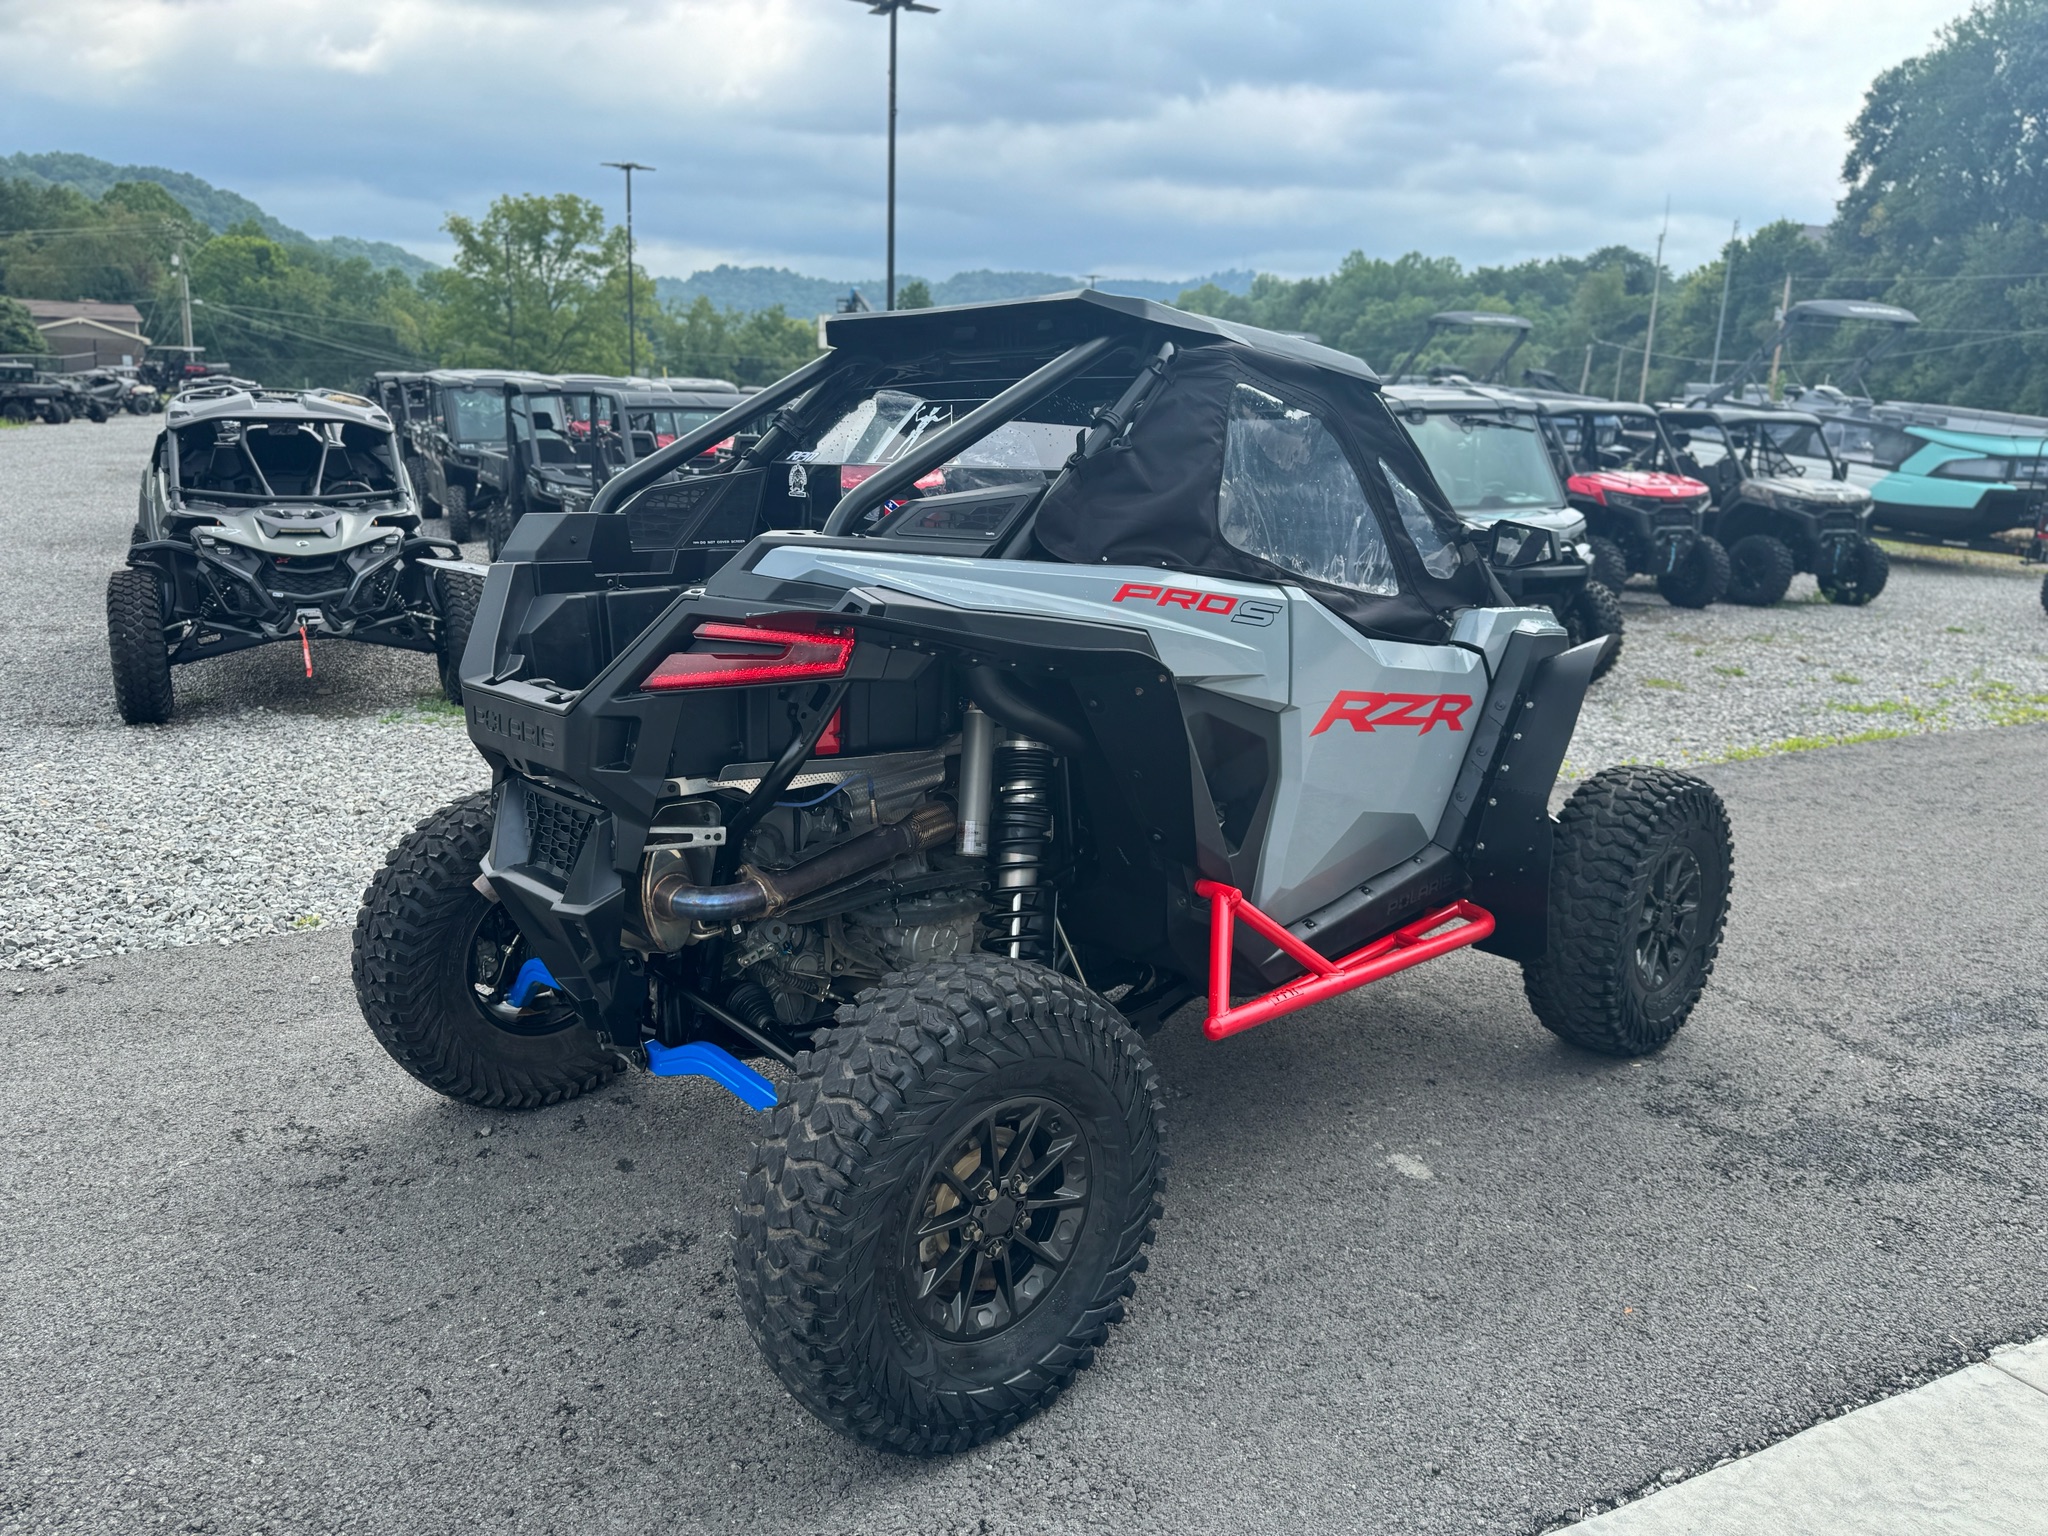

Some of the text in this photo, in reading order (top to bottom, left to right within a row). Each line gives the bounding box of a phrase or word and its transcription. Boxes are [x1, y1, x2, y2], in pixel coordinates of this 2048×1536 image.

[1112, 583, 1283, 627] PRO S
[473, 705, 555, 752] POLARIS
[1309, 690, 1473, 737] RZR
[1387, 873, 1453, 916] POLARIS
